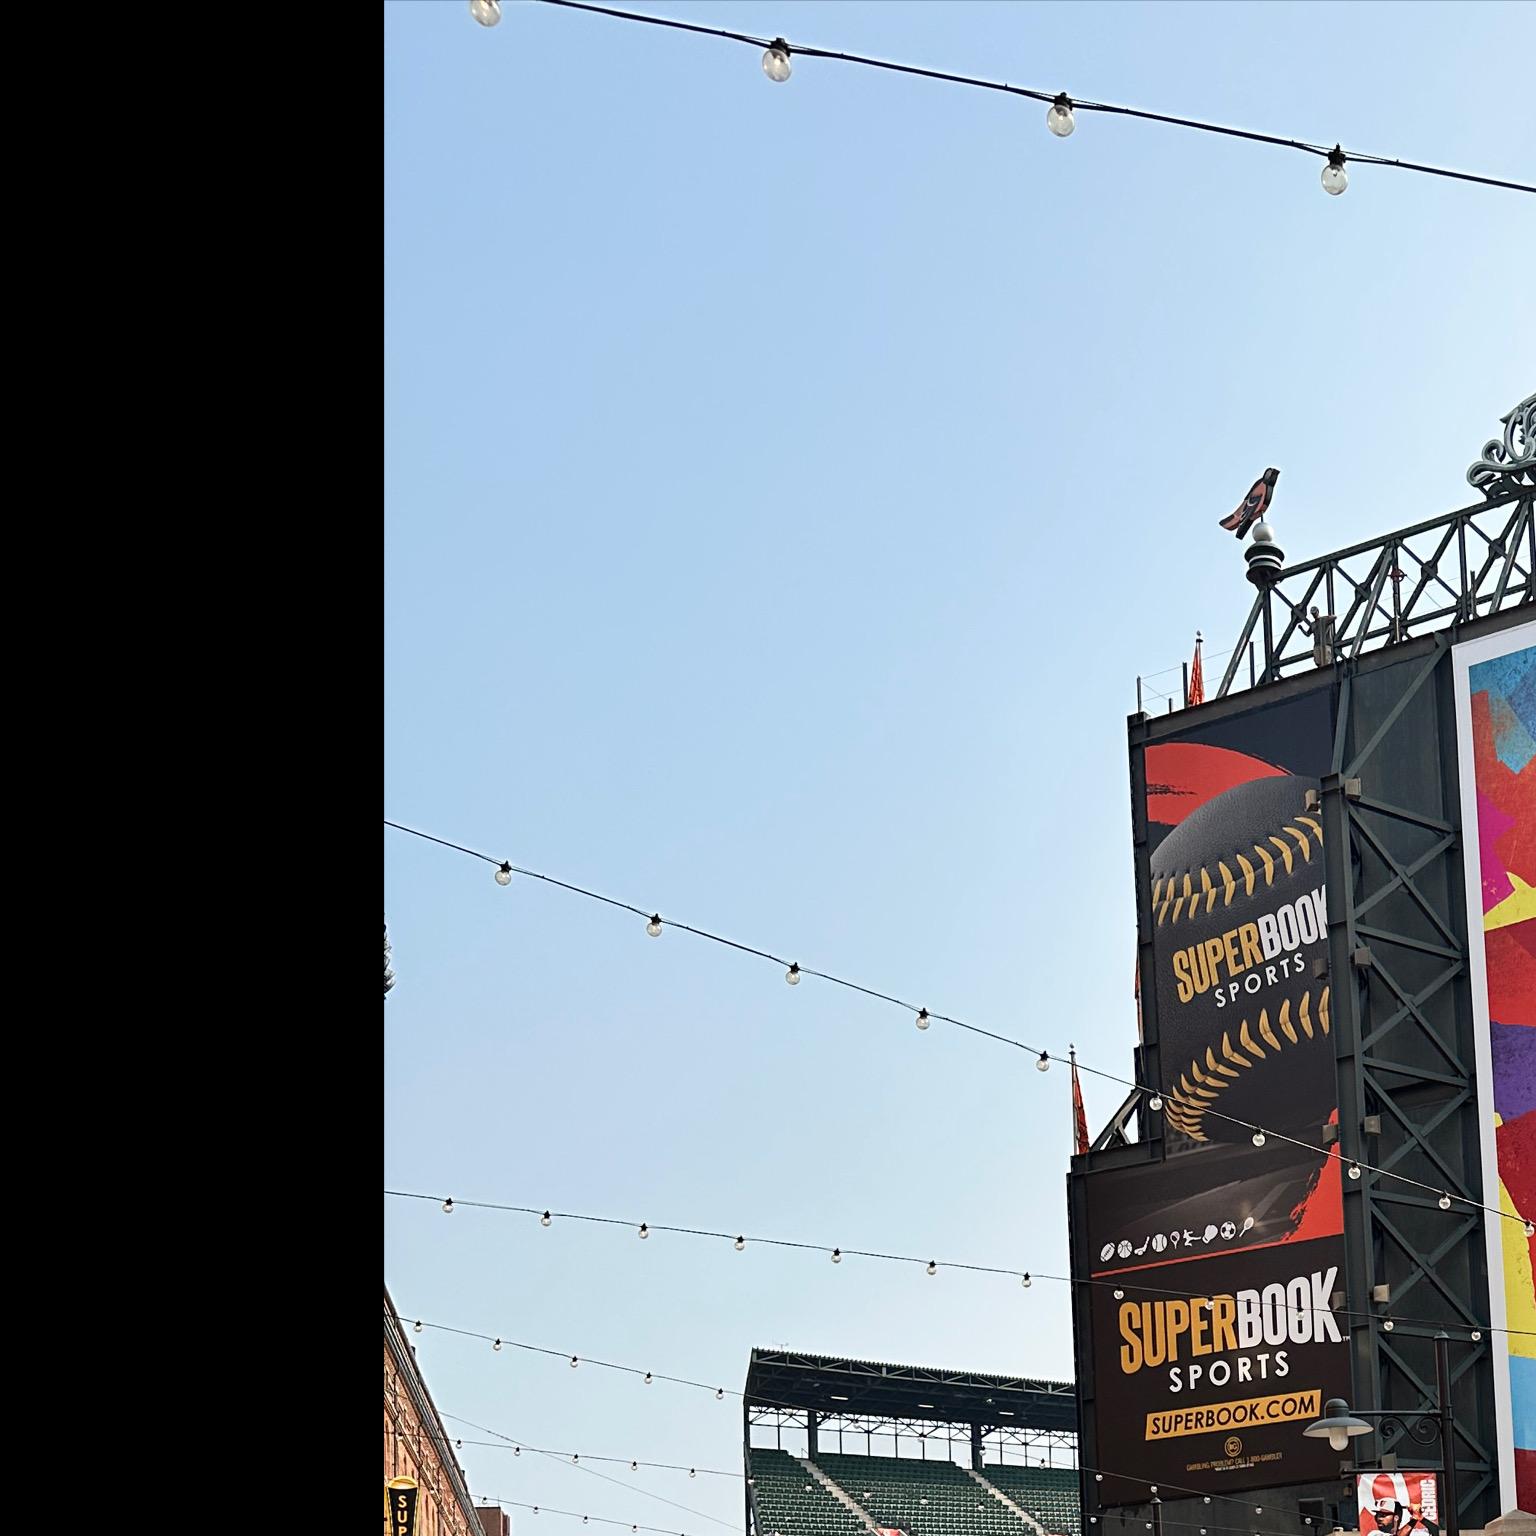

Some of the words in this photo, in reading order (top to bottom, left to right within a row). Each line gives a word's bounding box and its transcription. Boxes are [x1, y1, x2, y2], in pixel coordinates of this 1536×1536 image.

[1173, 884, 1327, 1003] SUPERBOOK
[1214, 953, 1305, 1008] SPORTS
[1119, 1266, 1343, 1374] SUPERBOOK
[1169, 1350, 1289, 1393] SPORTS
[1151, 1395, 1315, 1435] SUPERBOOK.COM
[1420, 1479, 1438, 1520] CEDRIC
